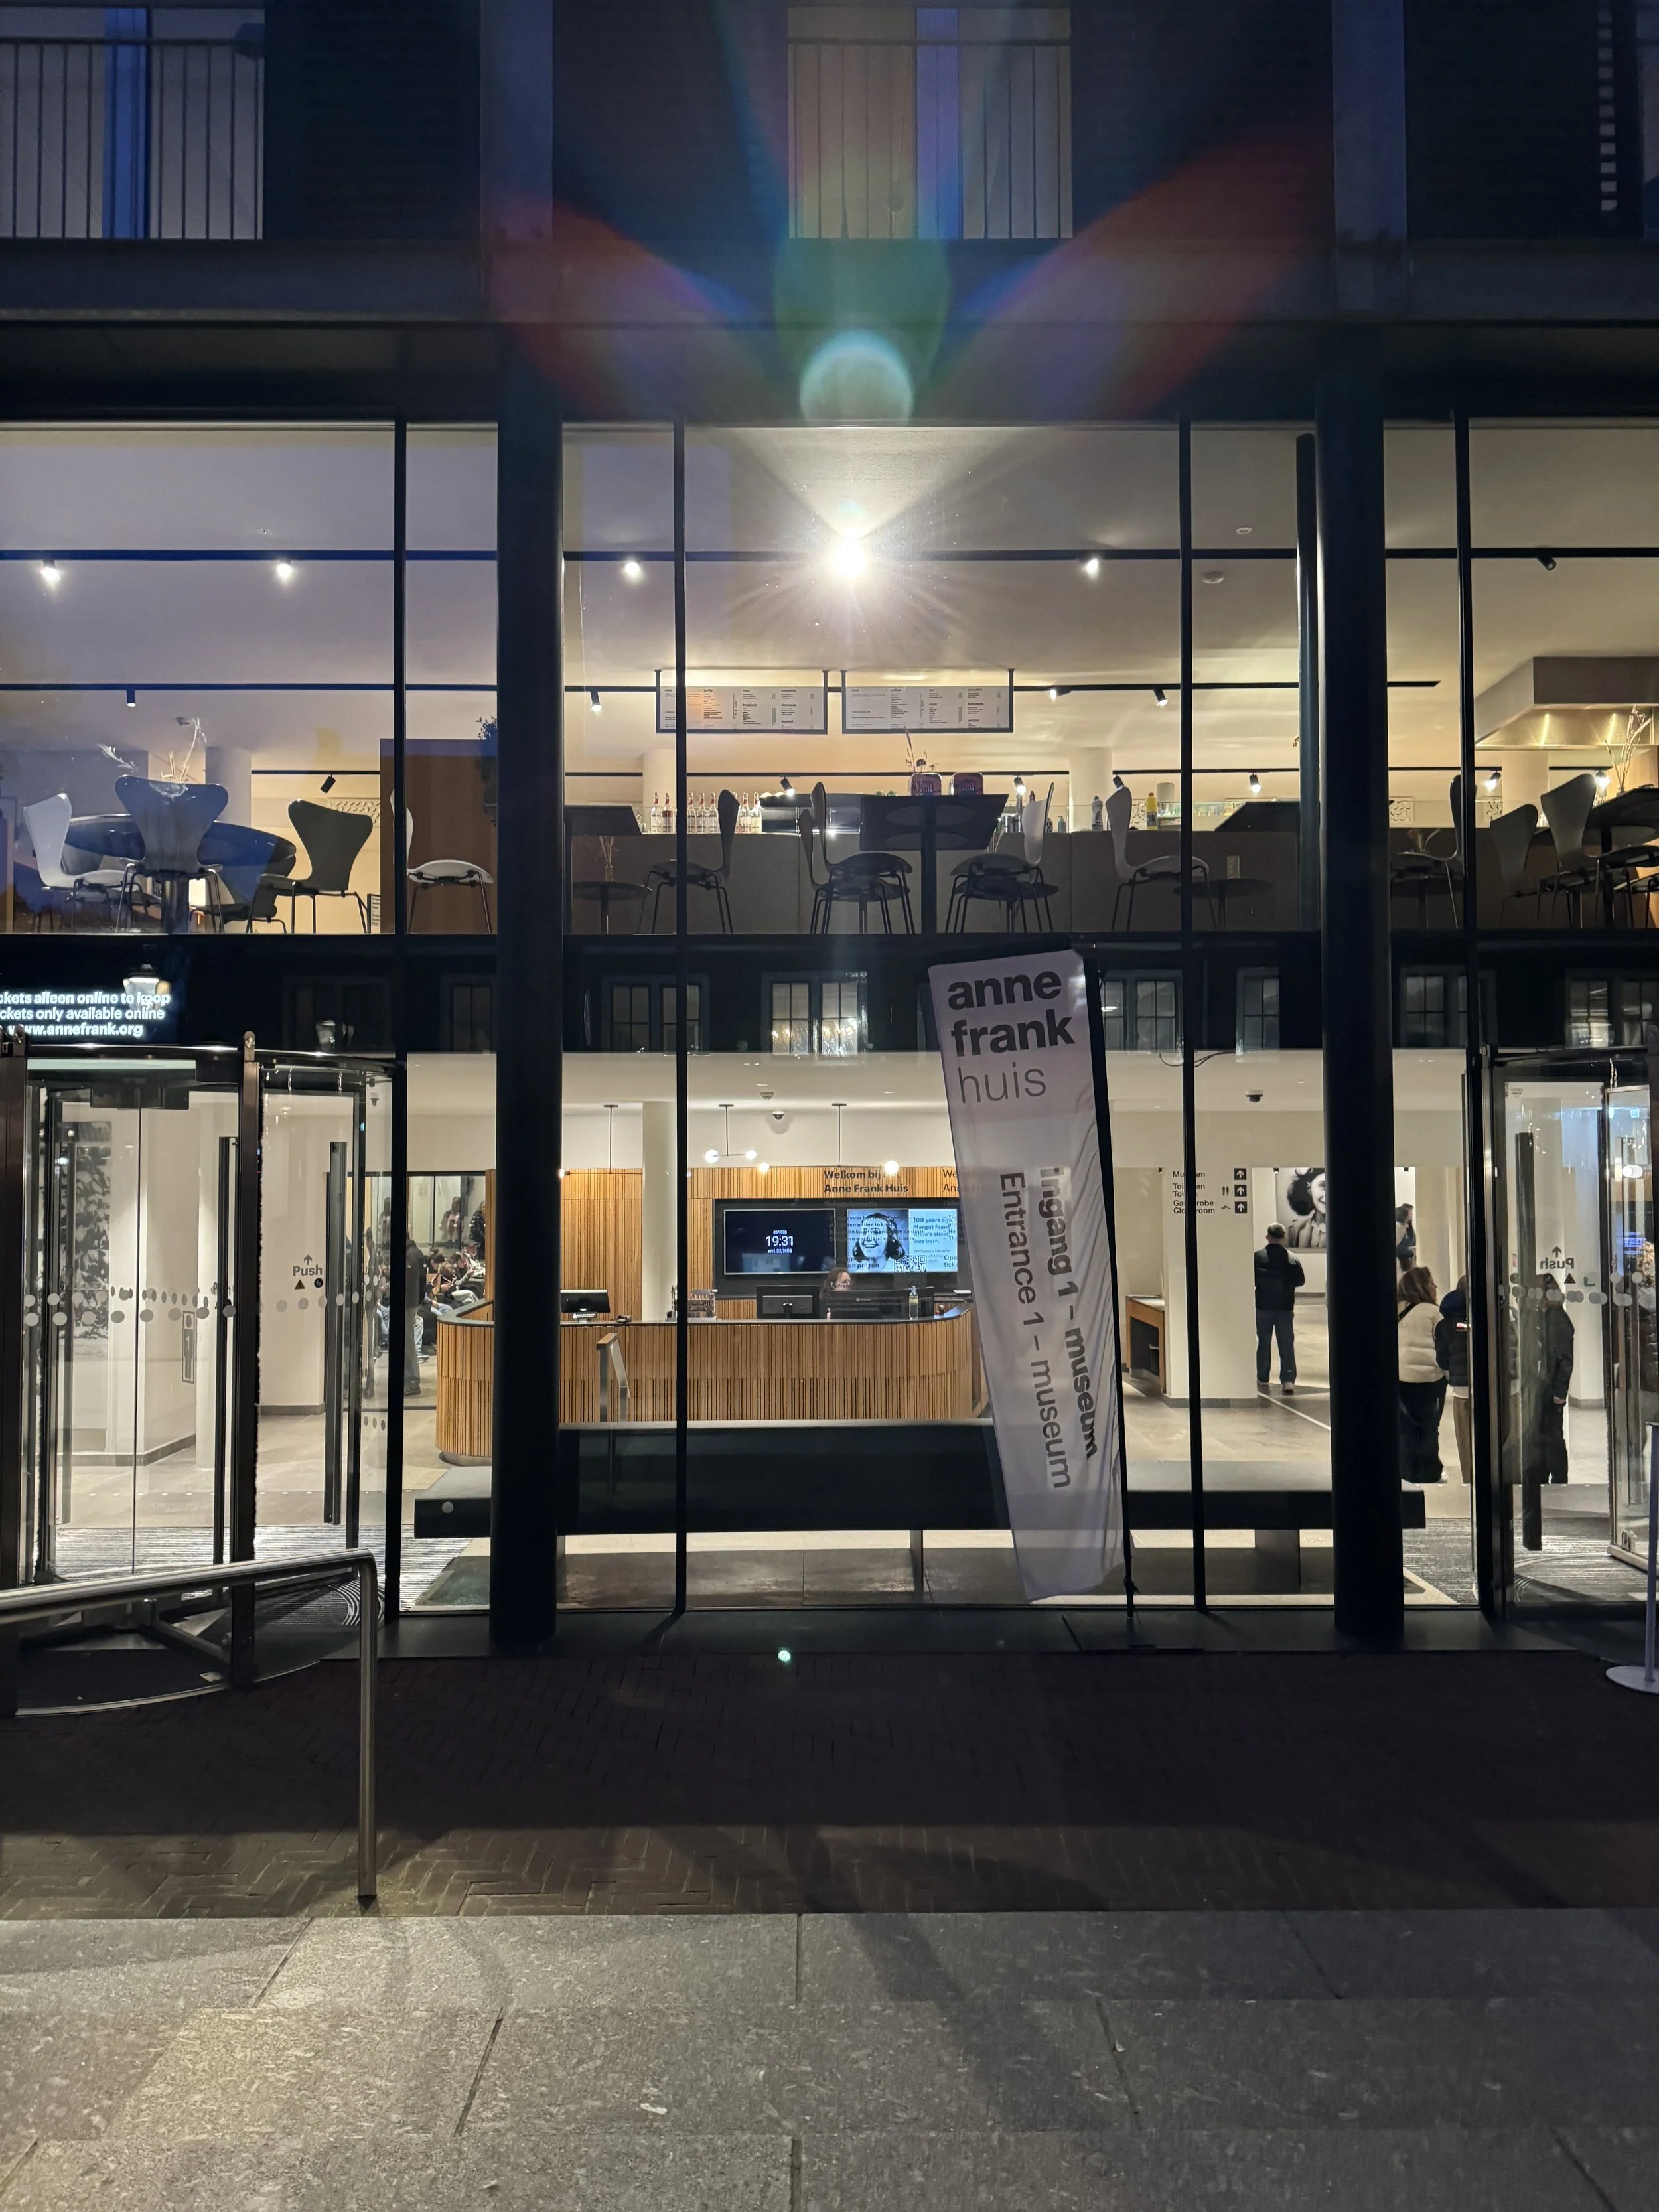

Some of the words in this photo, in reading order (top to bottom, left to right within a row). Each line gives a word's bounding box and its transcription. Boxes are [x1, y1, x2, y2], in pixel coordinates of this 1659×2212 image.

[34, 991, 74, 1005] alleen
[77, 991, 118, 1005] online
[120, 993, 135, 1005] te
[137, 992, 171, 1007] koop
[948, 971, 1062, 1010] anne
[36, 1007, 64, 1022] only
[66, 1007, 123, 1020] available
[125, 1007, 165, 1020] online
[951, 1009, 1076, 1057] frank
[958, 1062, 1046, 1104] huis
[824, 1170, 865, 1179] Welkom
[868, 1170, 881, 1179] bij
[824, 1184, 851, 1193] Anne
[854, 1184, 883, 1193] Frank
[885, 1183, 908, 1193] Huis
[1038, 1167, 1072, 1276] ingang
[766, 1235, 794, 1247] 19:31
[1000, 1172, 1037, 1305] Entrance
[293, 1264, 323, 1276] Push
[1058, 1280, 1079, 1297] 1
[1023, 1311, 1045, 1326] 1
[1064, 1327, 1098, 1461] museum
[1031, 1359, 1071, 1488] museum
